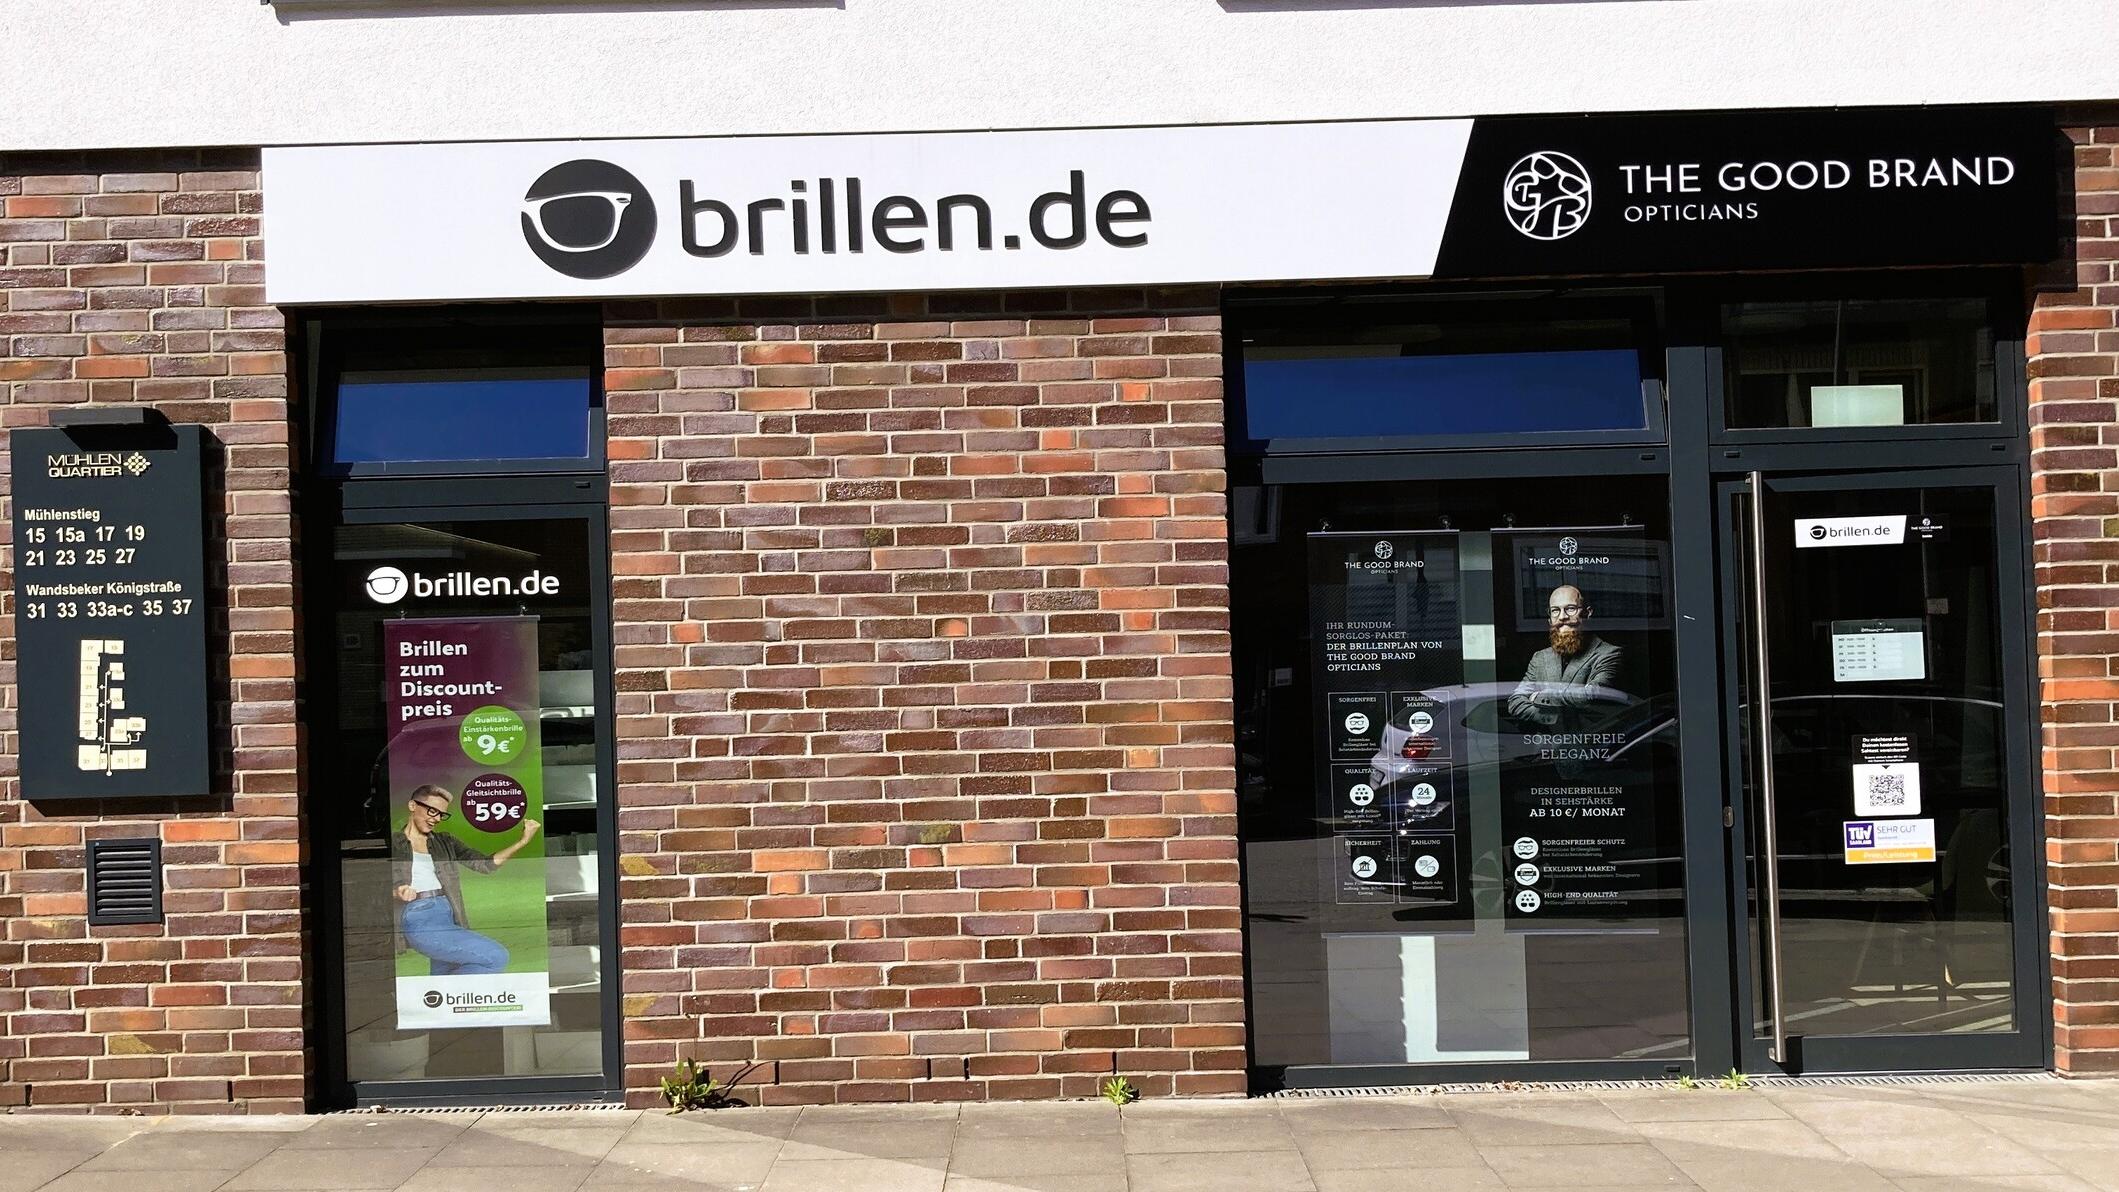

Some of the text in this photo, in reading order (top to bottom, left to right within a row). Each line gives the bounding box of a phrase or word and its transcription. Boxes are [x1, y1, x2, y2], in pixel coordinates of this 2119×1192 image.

[1619, 156, 2016, 194] THE GOOD BRAND
[679, 169, 1152, 258] brillen.de
[1624, 202, 1759, 223] OPTICIANS
[48, 452, 122, 466] MÜHLEN
[48, 466, 122, 478] QUARTIER
[24, 508, 101, 523] Mühlenstieg
[25, 525, 145, 543] 15 15a 17 19
[1829, 525, 1891, 538] brillen.de
[25, 548, 136, 566] 21 23 25 27
[1549, 557, 1576, 565] GOOD
[1578, 556, 1610, 564] BRAND
[1344, 560, 1424, 569] THE GOOD BRAND
[26, 581, 182, 597] Wandsbeker Königstraße
[414, 570, 560, 597] brillen.de
[27, 599, 193, 619] 31 33 33a-c 35 37
[1326, 621, 1396, 630] IHR RUNDUM-
[400, 641, 468, 657] Brillen
[1326, 641, 1443, 651] DER BRILLENPLAN VON
[1327, 652, 1416, 661] THE GOOD BRAND
[400, 664, 444, 677] zum
[1327, 663, 1381, 672] OPTICIANS
[401, 681, 502, 697] Discount-
[401, 701, 453, 720] preis
[474, 716, 512, 725] Qualitäts-
[463, 724, 524, 733] Einstärkenbrille
[463, 735, 473, 743] ab
[1523, 733, 1626, 745] SORGENFREIE
[1541, 748, 1611, 760] ELEGANZ
[475, 779, 513, 788] Qualitäts-
[466, 788, 522, 797] Gleitsichtbrille
[1417, 787, 1430, 796] 24
[1531, 787, 1623, 795] DESIGNERBRILLEN
[466, 798, 476, 806] ab
[1541, 796, 1614, 806] IN SEHSTÄRKE
[1529, 809, 1546, 818] AB
[1550, 809, 1562, 817] 10
[1582, 808, 1626, 817] MONAT
[1848, 825, 1872, 840] TÜV
[1876, 825, 1898, 834] SEHR
[1900, 824, 1917, 833] GUT
[1582, 890, 1619, 898] QUALITÄT
[446, 991, 516, 1005] brillen.de
